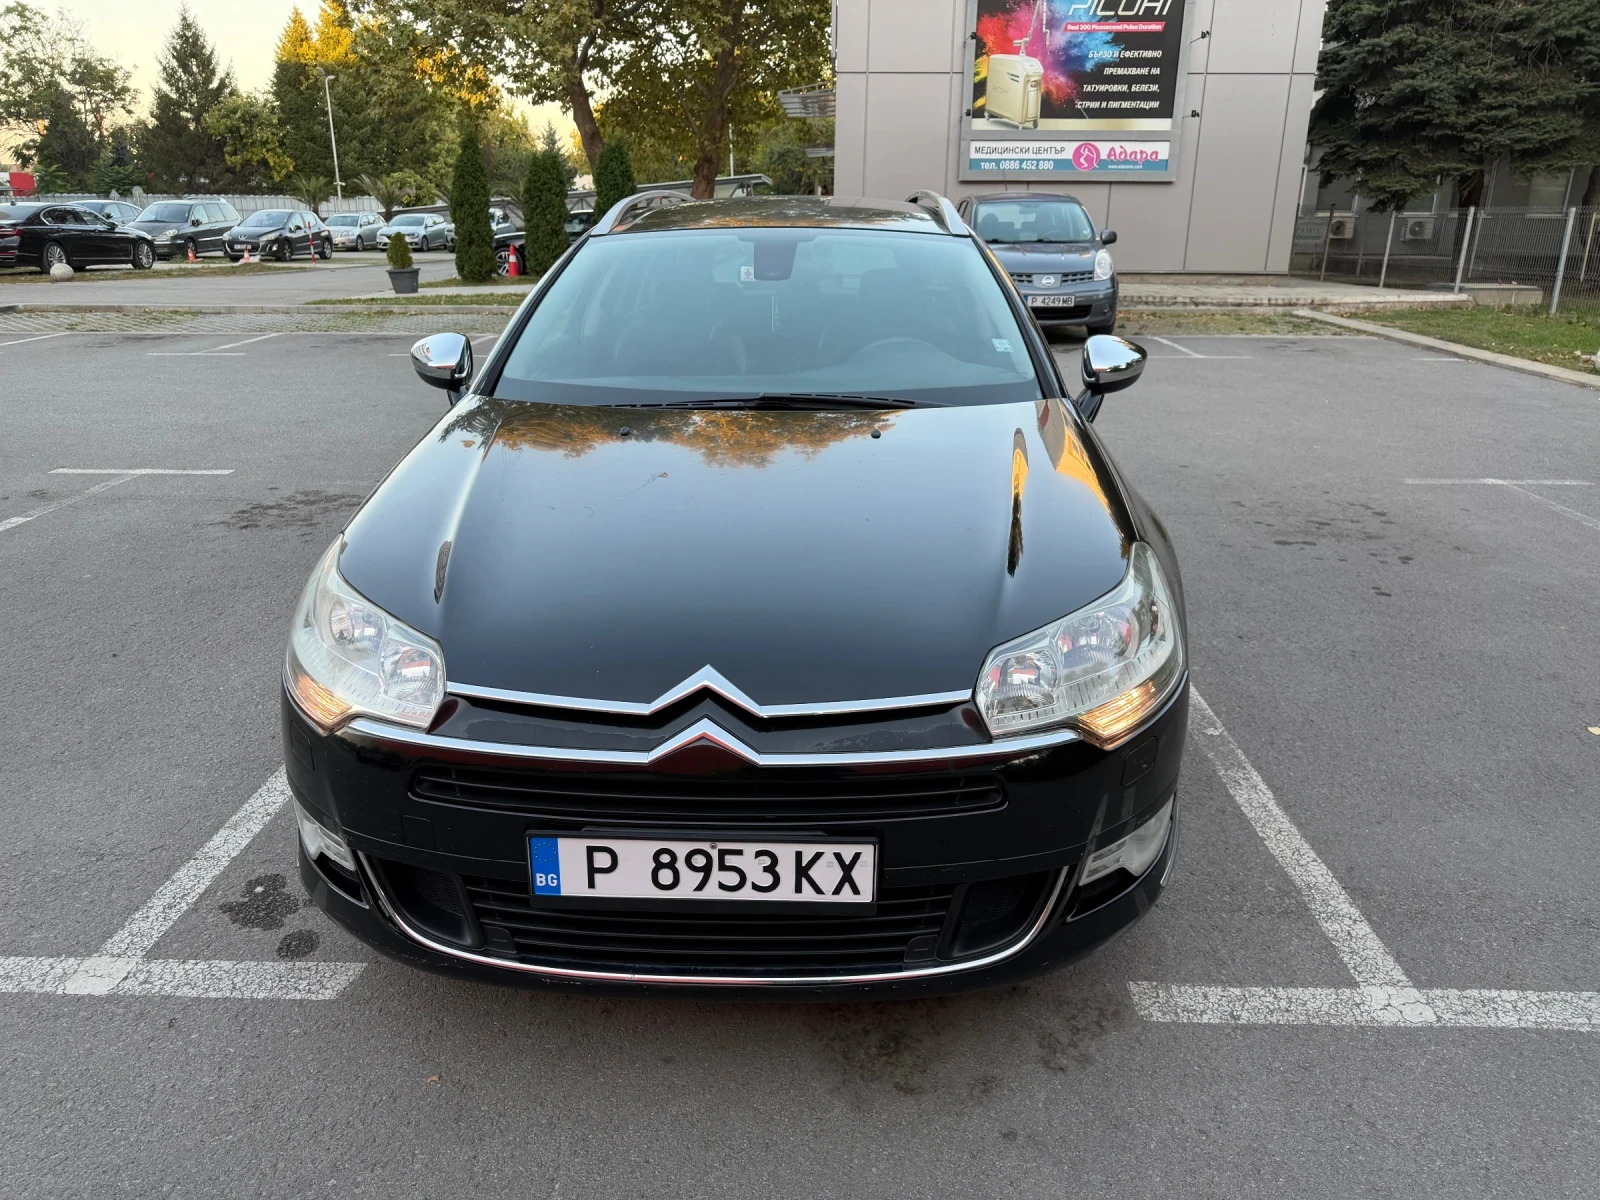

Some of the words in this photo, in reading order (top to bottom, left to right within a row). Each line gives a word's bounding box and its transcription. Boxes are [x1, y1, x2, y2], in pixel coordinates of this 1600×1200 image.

[1088, 50, 1112, 58] БЪРЗО
[1120, 50, 1162, 58] ЕФЕКТИВНО
[1082, 84, 1129, 92] ТАТУИРОВКИ,
[1131, 84, 1160, 92] БЕЛЕЗИ,
[1108, 101, 1160, 110] ПИГМЕНТАЦИИ
[974, 146, 1030, 155] МЕДИЦИНСКИ
[1032, 146, 1066, 155] ЦЕНТЪР
[1106, 145, 1159, 164] Адара
[1000, 160, 1020, 170] 0886
[1021, 160, 1036, 170] 452
[1038, 160, 1054, 170] 880
[585, 845, 619, 889] P
[650, 847, 781, 893] 8953
[794, 850, 863, 896] KX
[536, 873, 558, 887] BG
